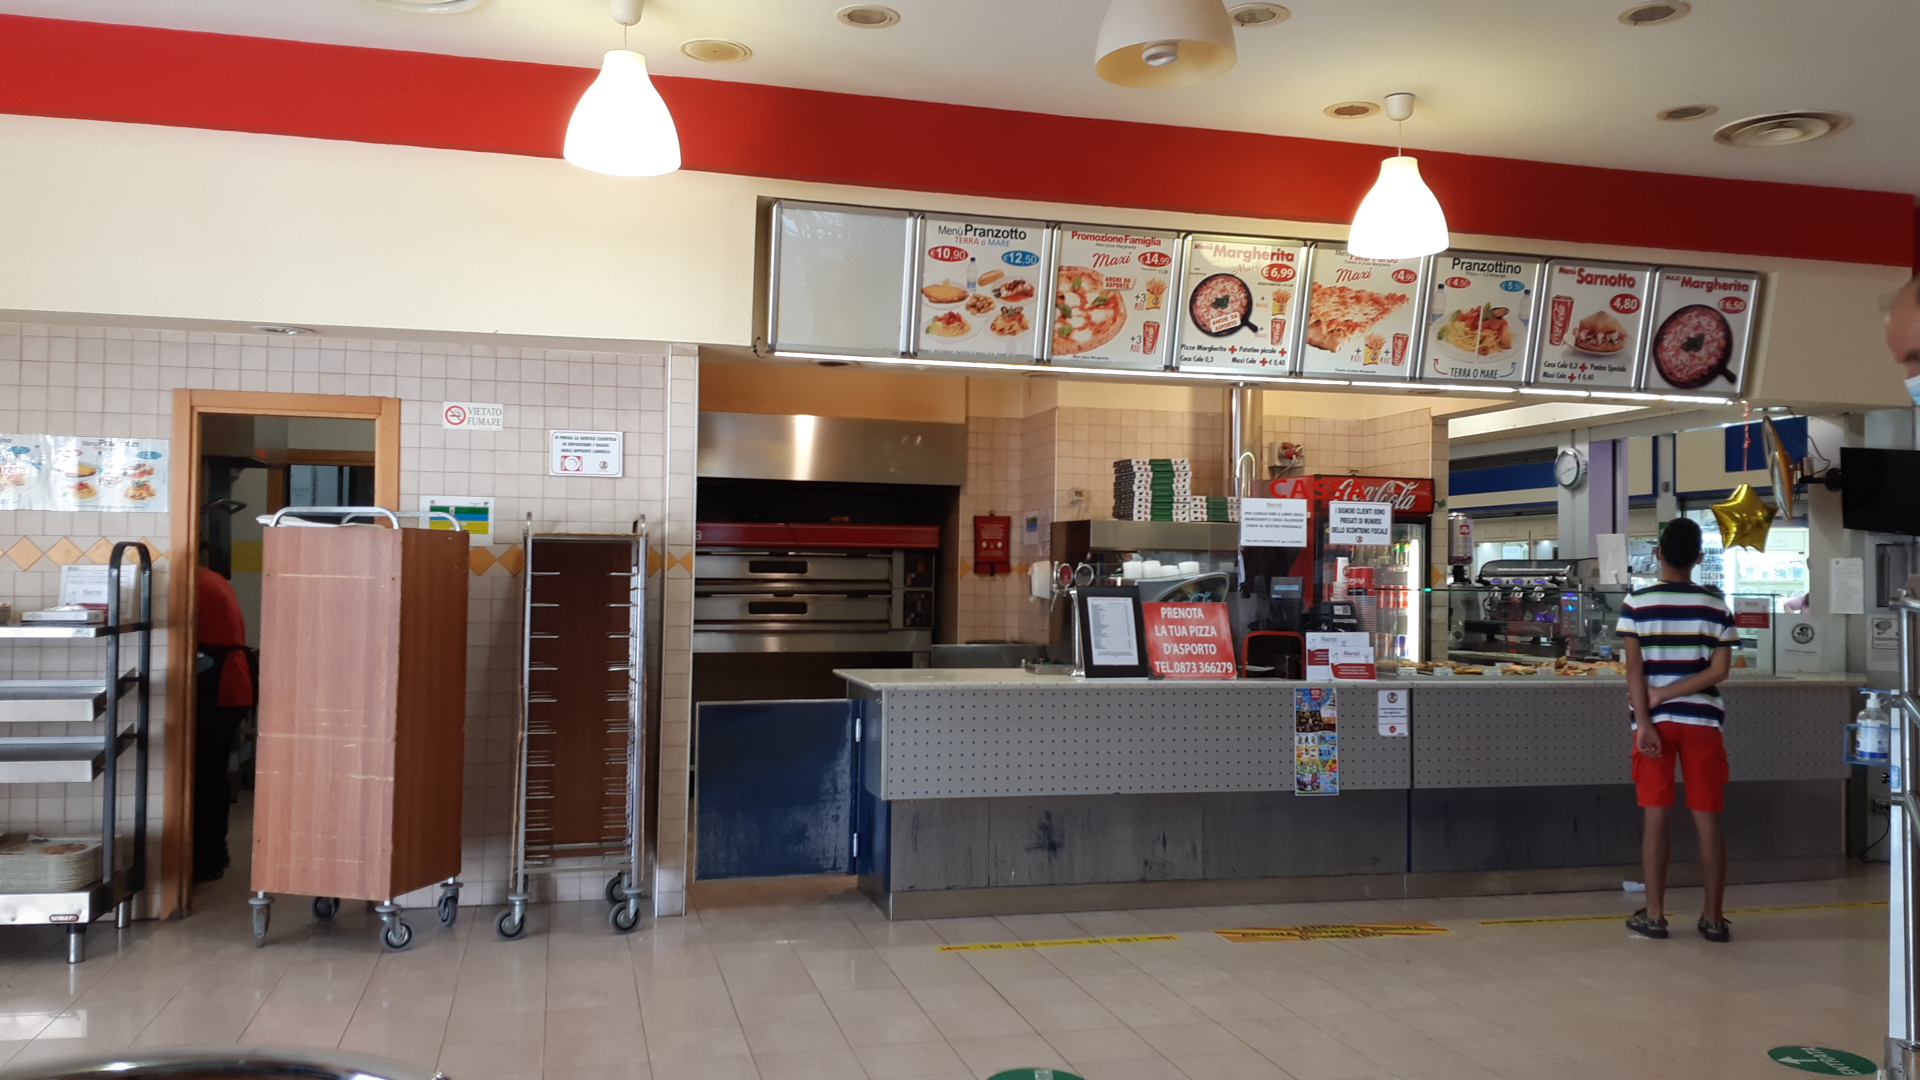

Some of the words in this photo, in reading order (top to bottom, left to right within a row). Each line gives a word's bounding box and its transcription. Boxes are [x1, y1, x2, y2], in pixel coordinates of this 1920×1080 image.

[938, 225, 963, 236] Menù
[964, 224, 1027, 240] Pranzotto
[954, 236, 980, 245] TERRA
[988, 239, 1010, 247] MARE
[1071, 231, 1124, 244] Promozione
[1124, 235, 1162, 248] Famiglia
[930, 247, 966, 261] €10,90
[1002, 252, 1037, 265] €12,50
[1139, 253, 1170, 266] €14,99
[1213, 244, 1295, 262] Margherita
[1092, 252, 1132, 268] Maxi
[1452, 258, 1522, 274] Pranzottino
[1336, 267, 1373, 284] Maxi
[1576, 267, 1636, 288] Sarnotto
[1681, 276, 1750, 293] Margherita
[1614, 298, 1638, 311] 4,80
[1196, 344, 1227, 352] Margherita
[1450, 368, 1471, 378] TERRA
[1472, 369, 1478, 378] O
[1480, 369, 1499, 379] MARE
[467, 406, 502, 417] VIETATO
[467, 417, 502, 426] FUMARE
[1269, 478, 1367, 500] CASSA
[1160, 607, 1204, 619] PRENOTA
[1155, 625, 1168, 636] LA
[1168, 625, 1188, 637] TUA
[1189, 626, 1218, 637] PIZZA
[1163, 643, 1217, 655] D'ASPORTO
[1154, 661, 1197, 673] TEL.0873
[1198, 662, 1233, 673] 366279
